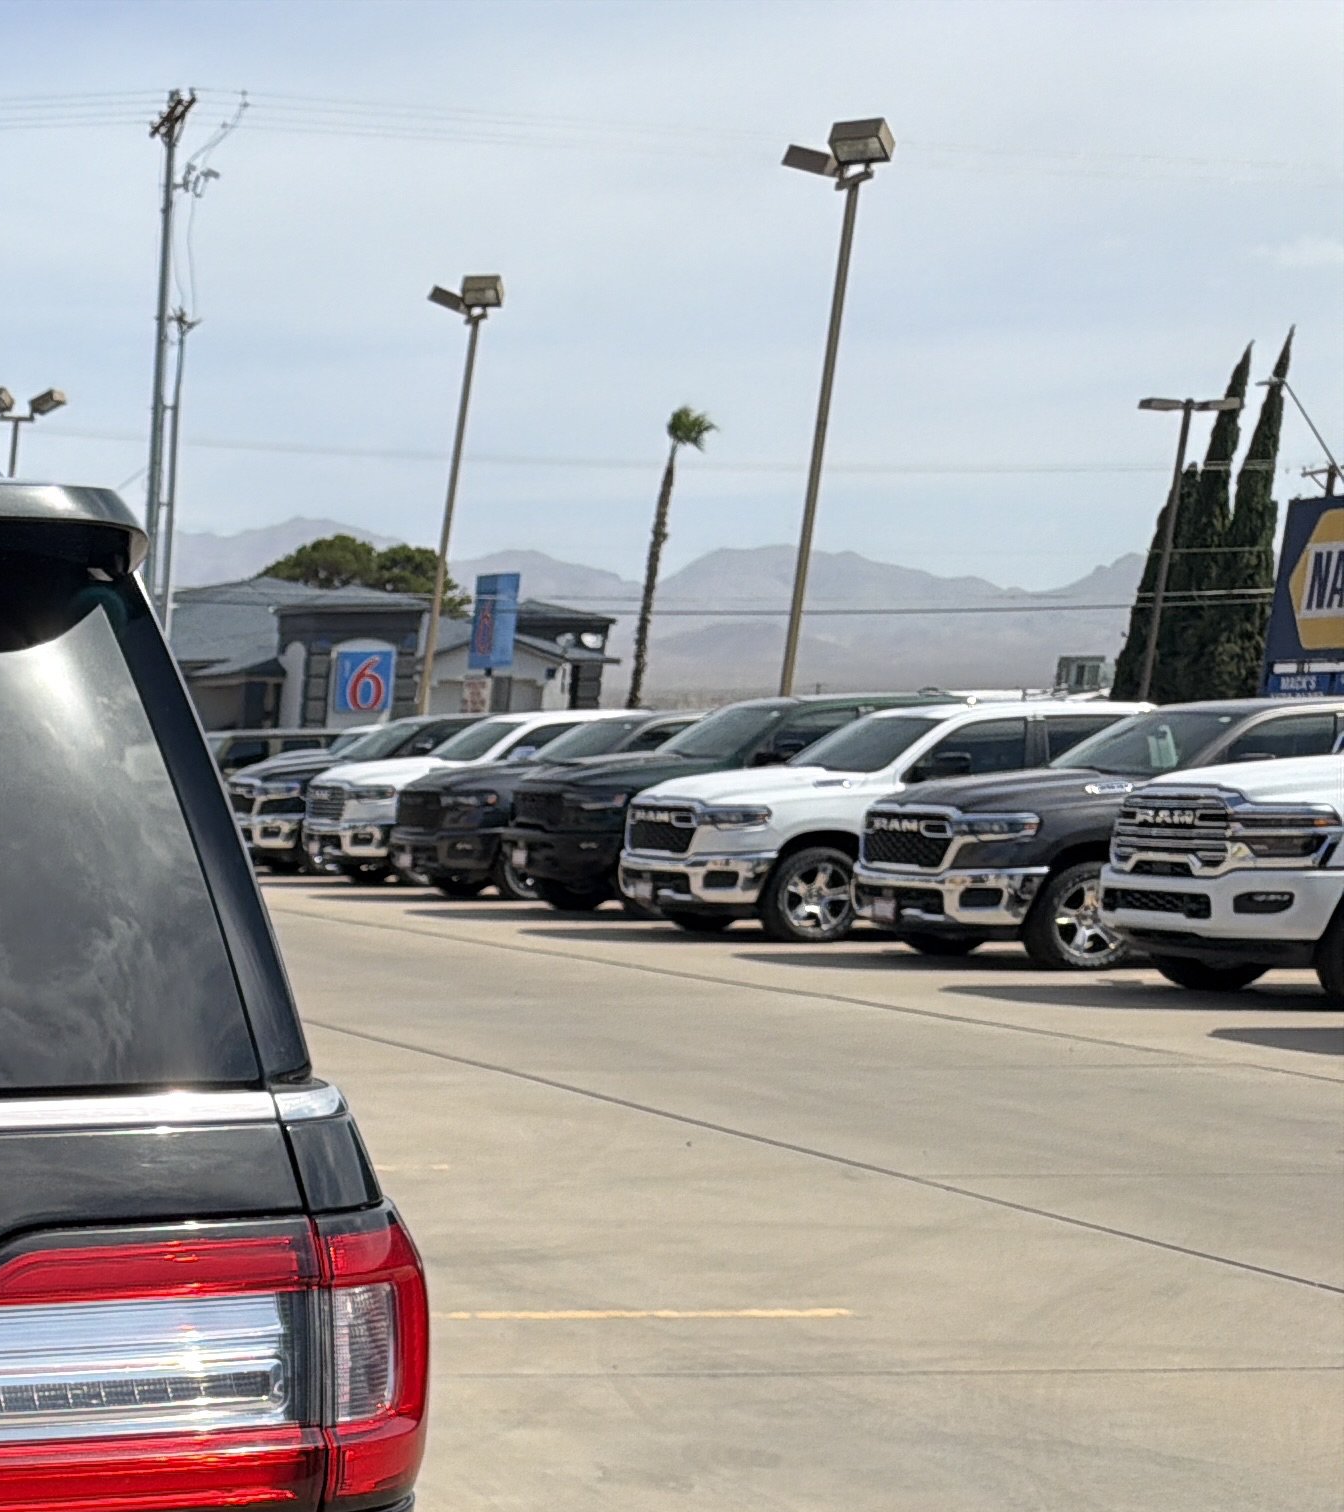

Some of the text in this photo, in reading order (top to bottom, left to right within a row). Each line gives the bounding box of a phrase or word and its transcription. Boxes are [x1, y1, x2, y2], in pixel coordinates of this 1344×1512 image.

[346, 656, 384, 711] 6
[1136, 808, 1193, 824] RAM
[873, 817, 918, 832] RAM
